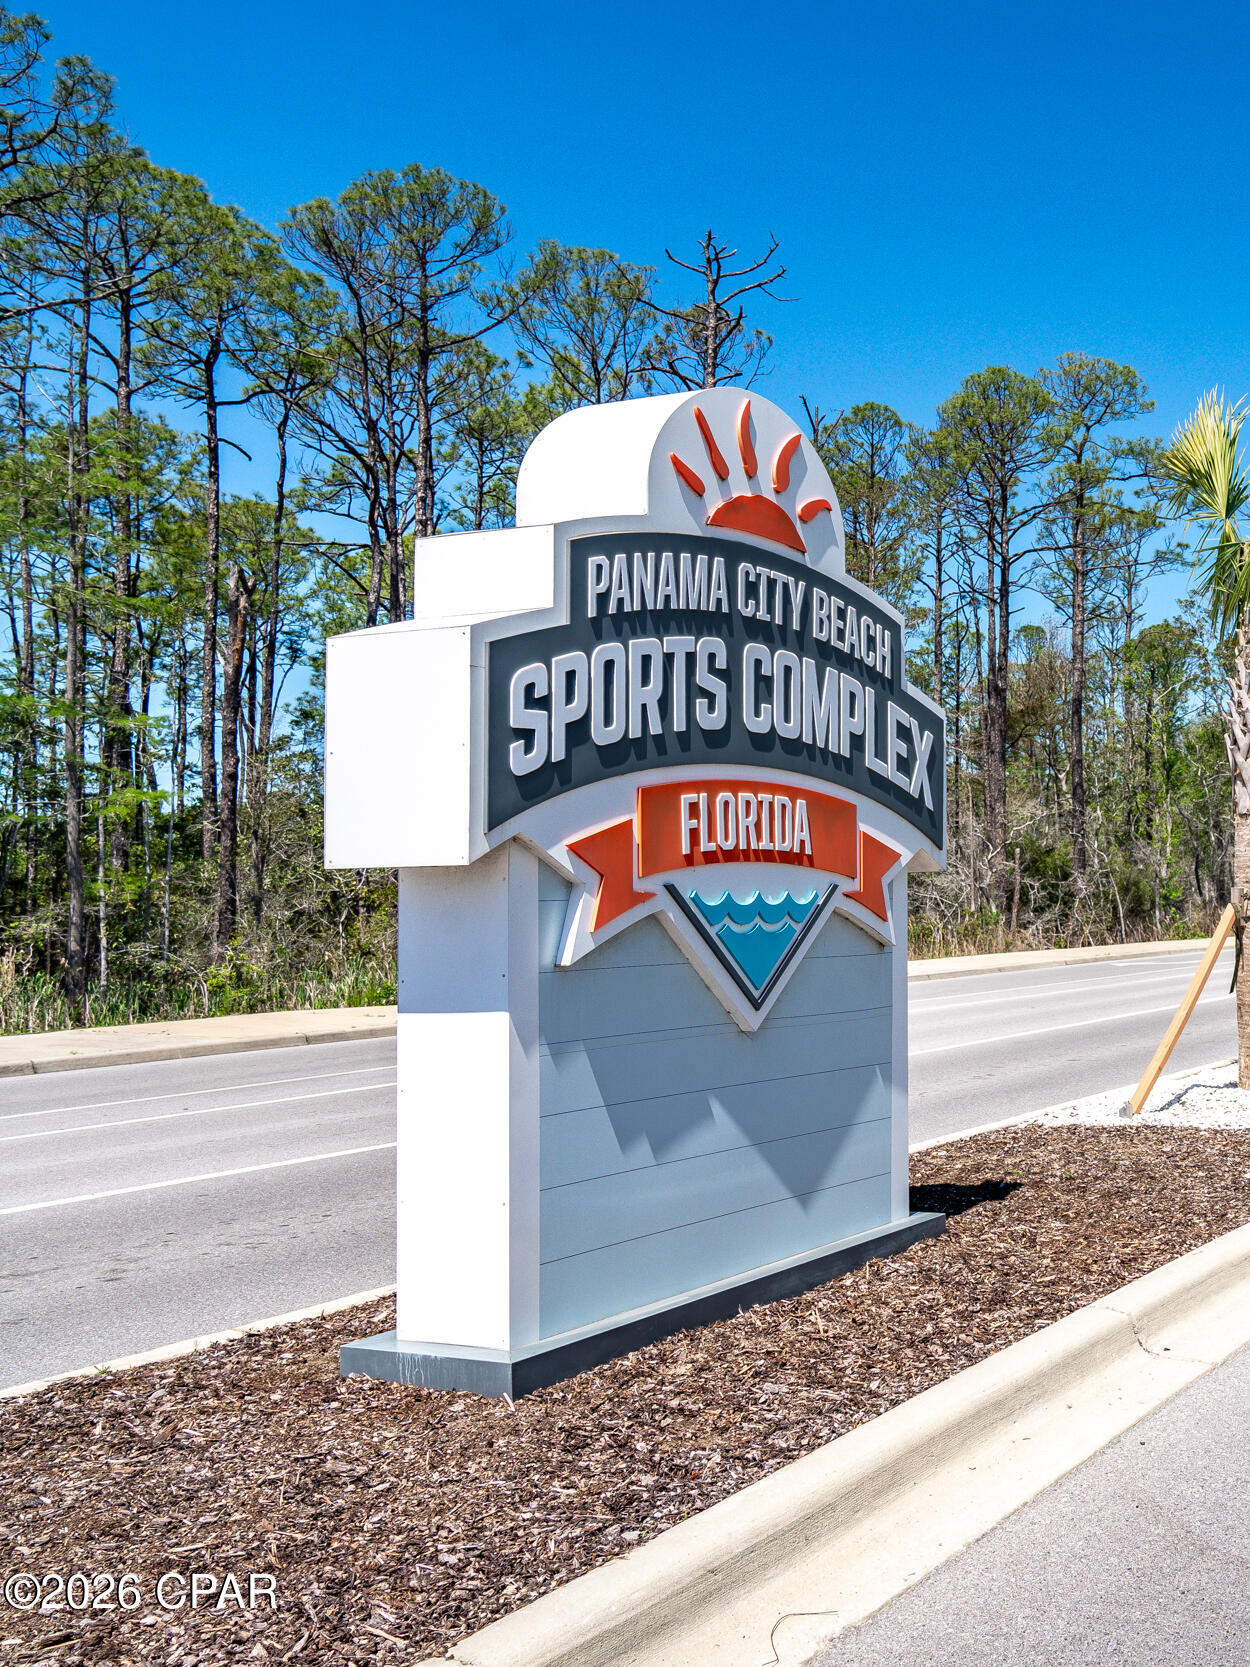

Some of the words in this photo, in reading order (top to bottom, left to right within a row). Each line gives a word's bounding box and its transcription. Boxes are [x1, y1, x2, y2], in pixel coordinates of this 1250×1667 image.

[588, 552, 729, 618] PANAMA
[738, 562, 806, 631] CITY
[812, 587, 892, 679] BEACH
[509, 636, 727, 776] SPORTS
[743, 642, 935, 812] COMPLEX
[680, 793, 812, 855] FLORIDA
